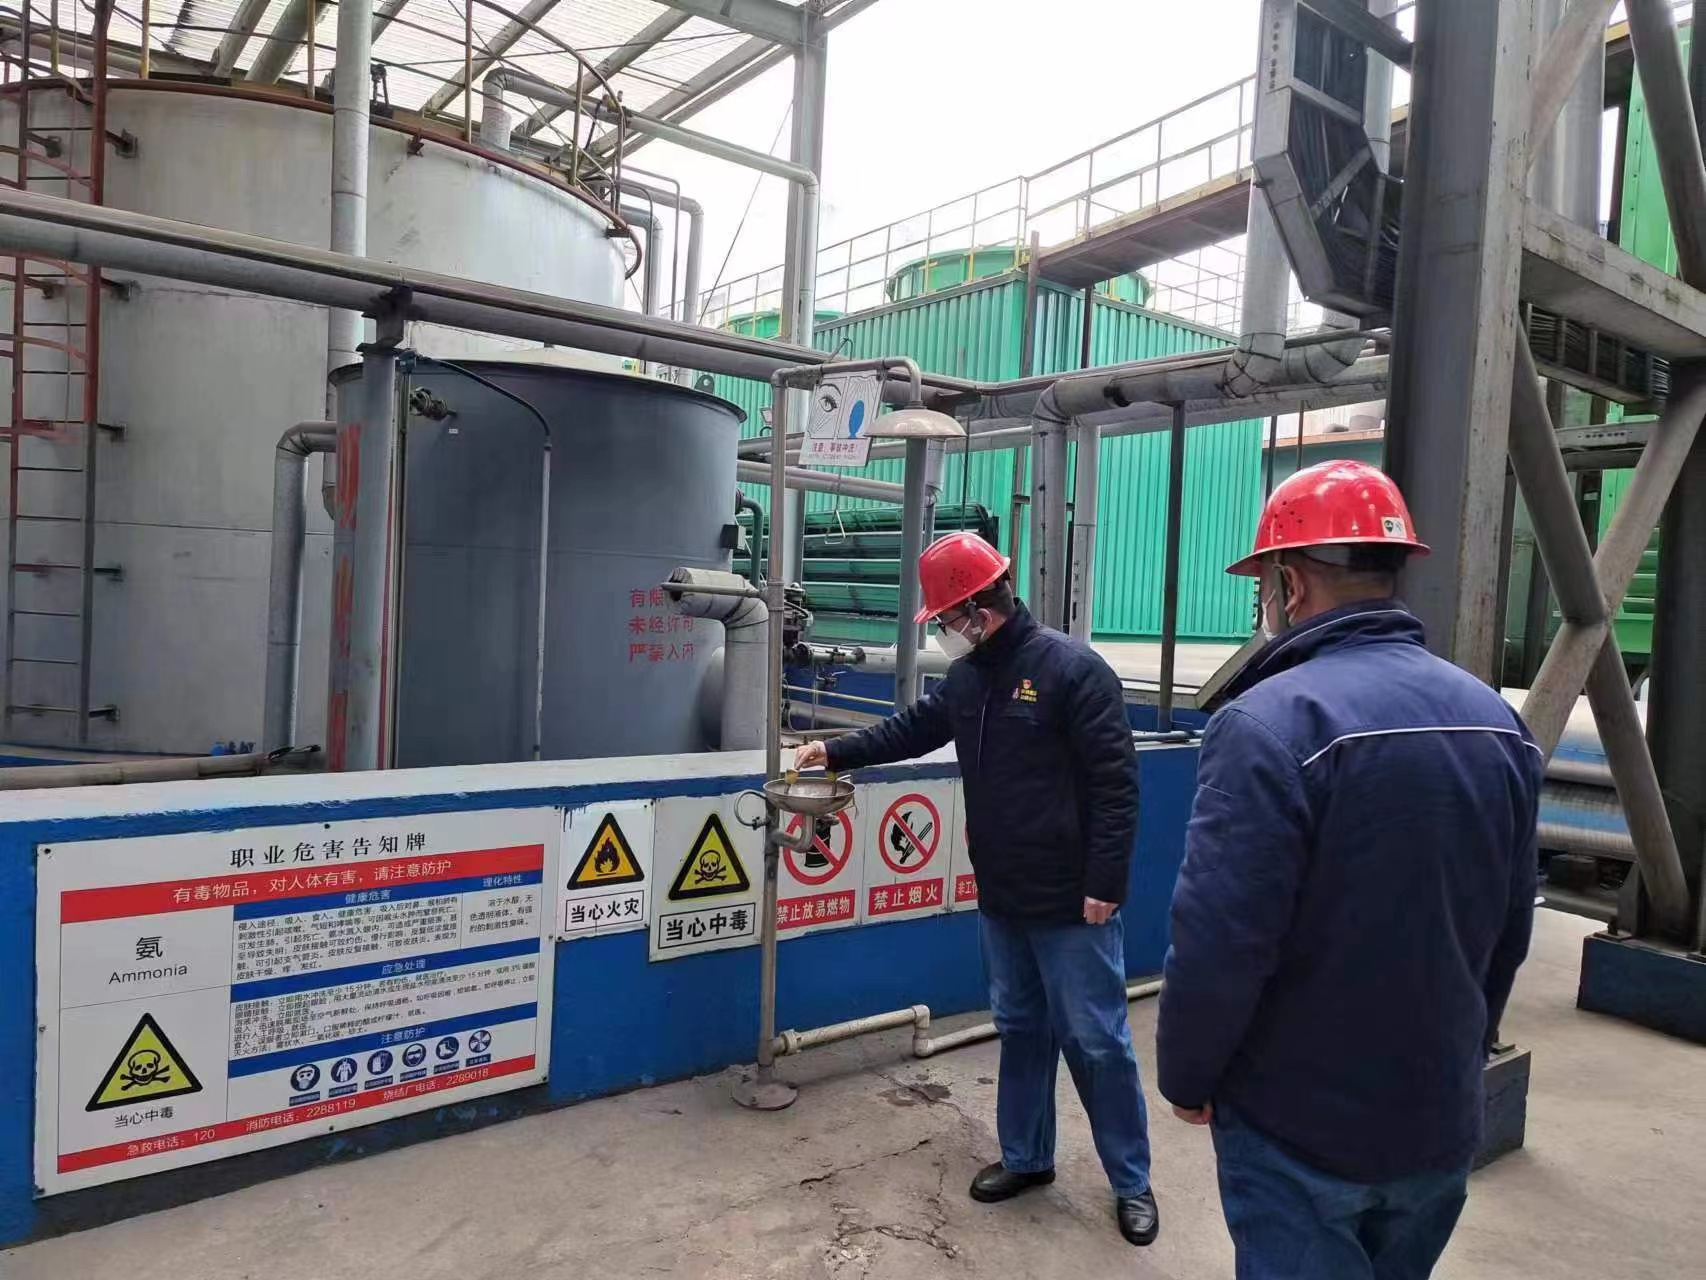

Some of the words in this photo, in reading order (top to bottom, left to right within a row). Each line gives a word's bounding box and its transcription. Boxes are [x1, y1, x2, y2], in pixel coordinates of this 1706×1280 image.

[628, 615, 694, 635] 未经许可
[628, 641, 695, 663] 严禁入内
[229, 832, 427, 868] 职业危害告知牌
[482, 874, 521, 887] 理化特性
[344, 889, 390, 904] 健康危害
[873, 882, 939, 910] 禁止烟火
[570, 897, 640, 923] 当心火灾
[776, 896, 851, 924] 禁止放易燃物
[665, 908, 749, 942] 当心中毒
[135, 935, 164, 960] 氨
[108, 962, 188, 985] Ammonia
[381, 958, 425, 975] 应急处理
[381, 1026, 425, 1044] 注意防护
[114, 1106, 174, 1129] 当心中毒
